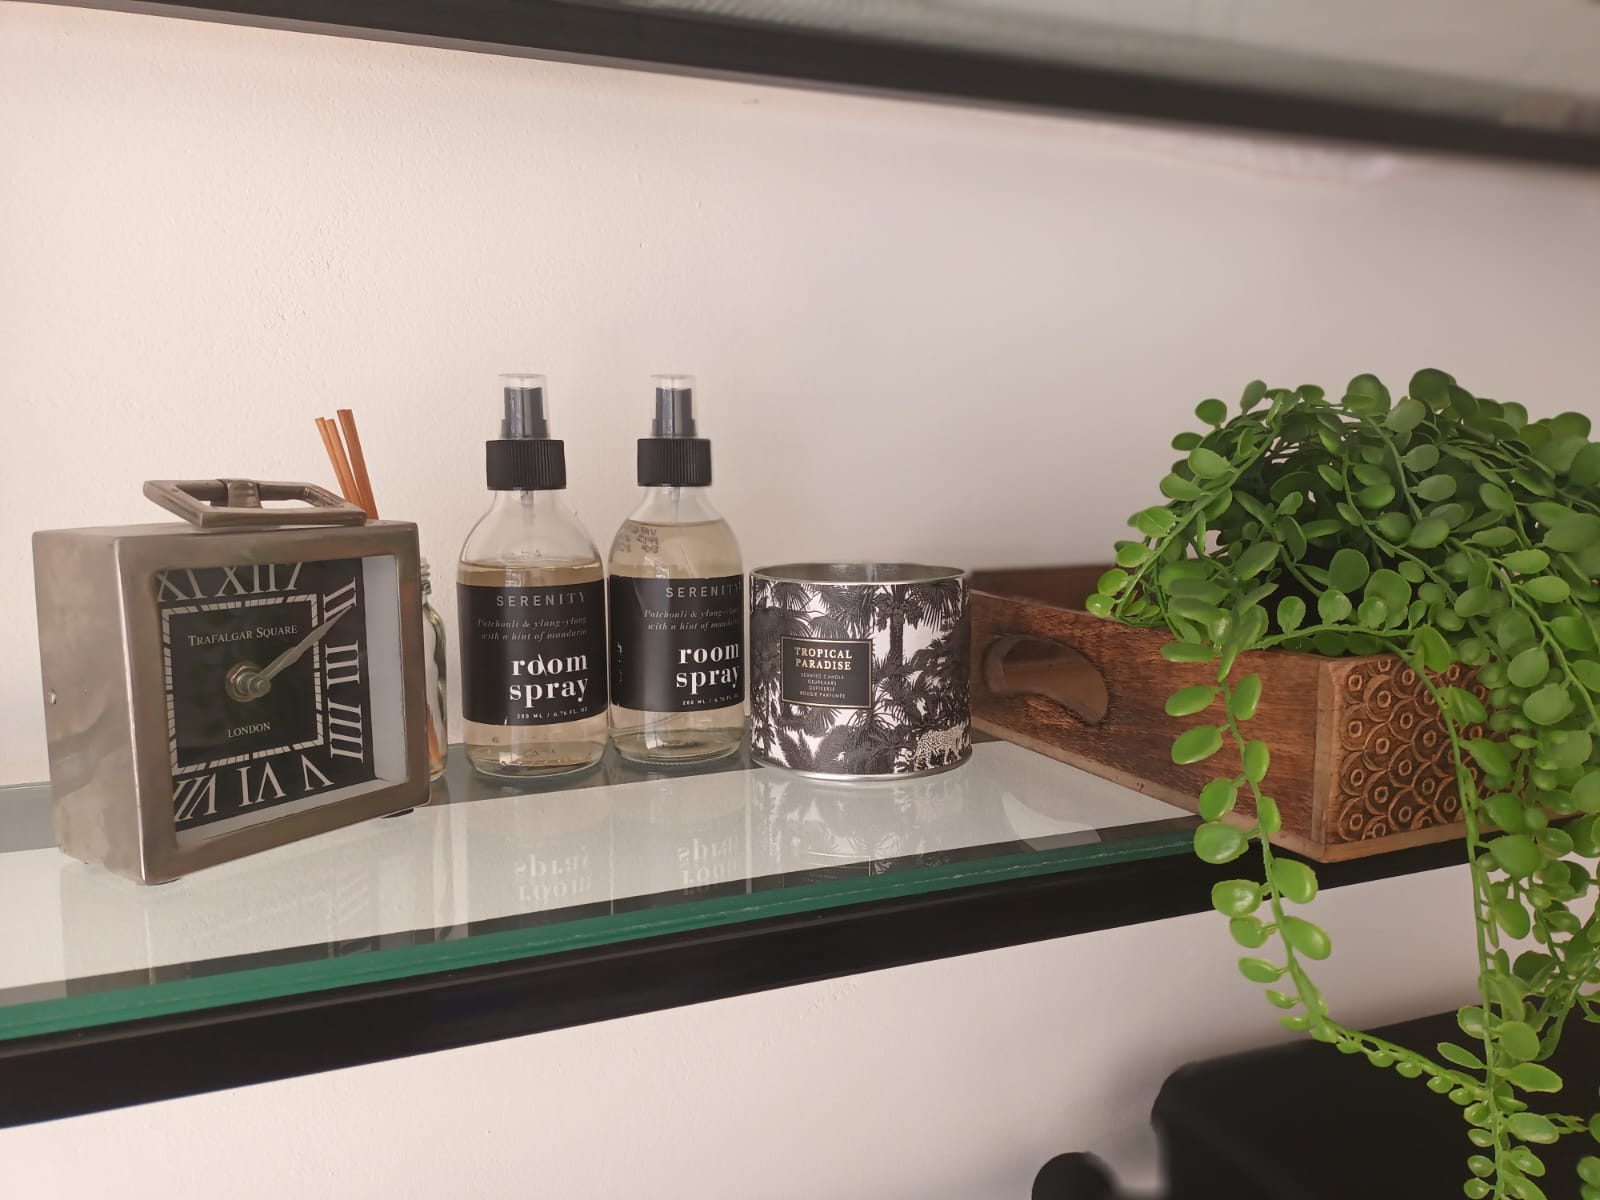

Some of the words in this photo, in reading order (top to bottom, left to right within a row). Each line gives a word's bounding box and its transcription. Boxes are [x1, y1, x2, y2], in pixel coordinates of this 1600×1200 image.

[156, 569, 208, 602] XI
[214, 563, 280, 597] XII
[496, 591, 585, 607] SERENITY
[648, 622, 668, 631] with
[511, 632, 532, 641] hint
[678, 643, 740, 664] room
[793, 646, 853, 659] TROPICAL
[325, 639, 361, 690] III
[511, 654, 589, 676] room
[795, 658, 852, 671] PARADISE
[676, 665, 740, 696] spray
[509, 678, 589, 709] spray
[226, 721, 272, 739] LONDON
